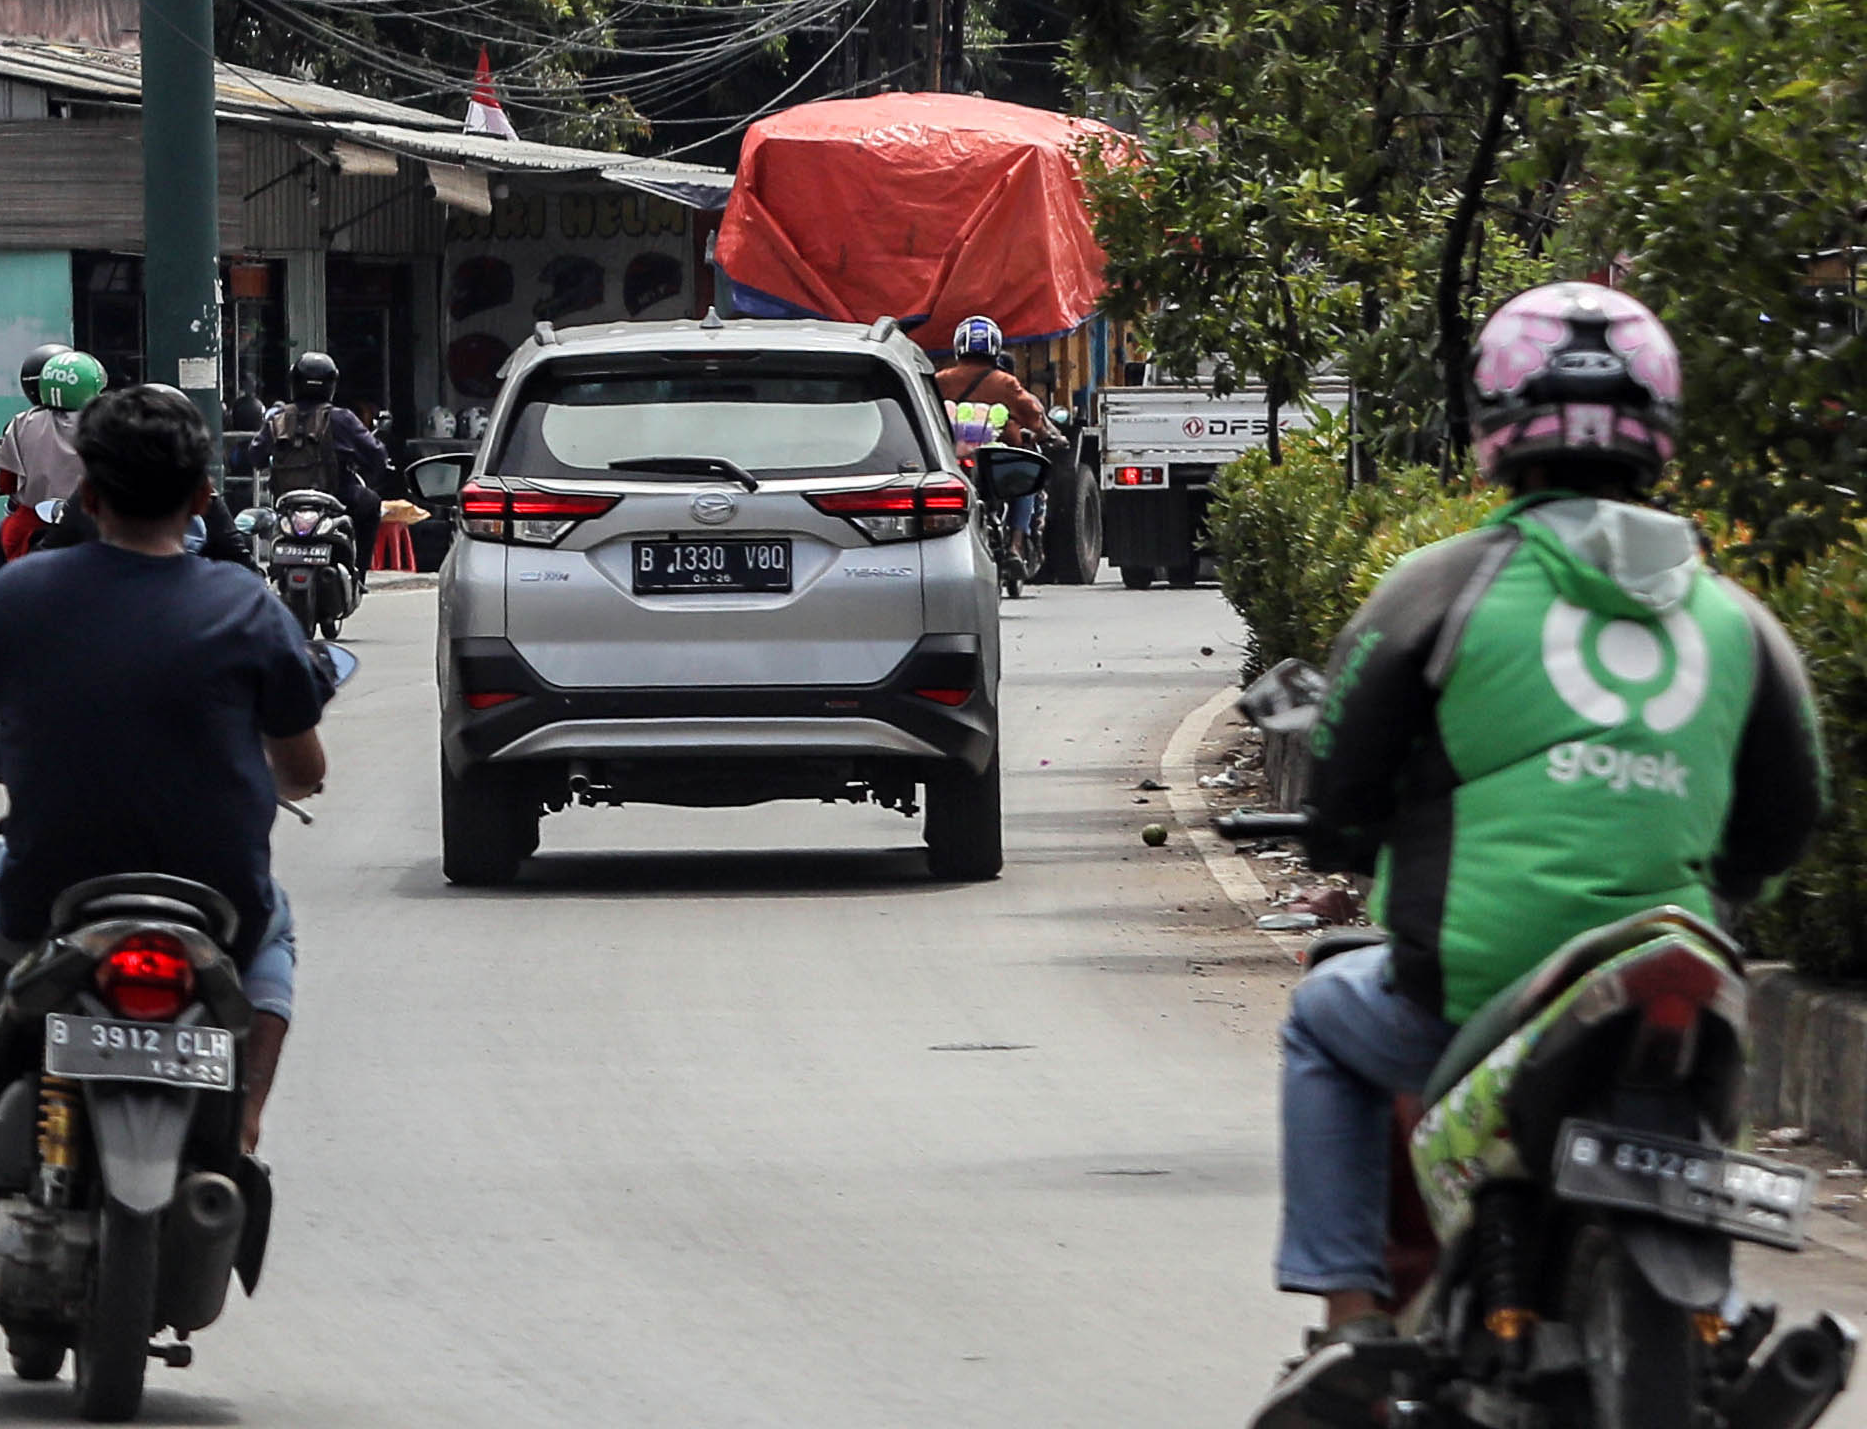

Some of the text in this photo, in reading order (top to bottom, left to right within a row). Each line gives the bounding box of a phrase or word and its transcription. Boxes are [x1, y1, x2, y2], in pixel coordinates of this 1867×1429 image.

[42, 364, 79, 385] Grab
[640, 548, 654, 571] B
[673, 546, 724, 571] 1330
[1546, 742, 1691, 796] gojek
[51, 1020, 228, 1057] B 3912 CLH
